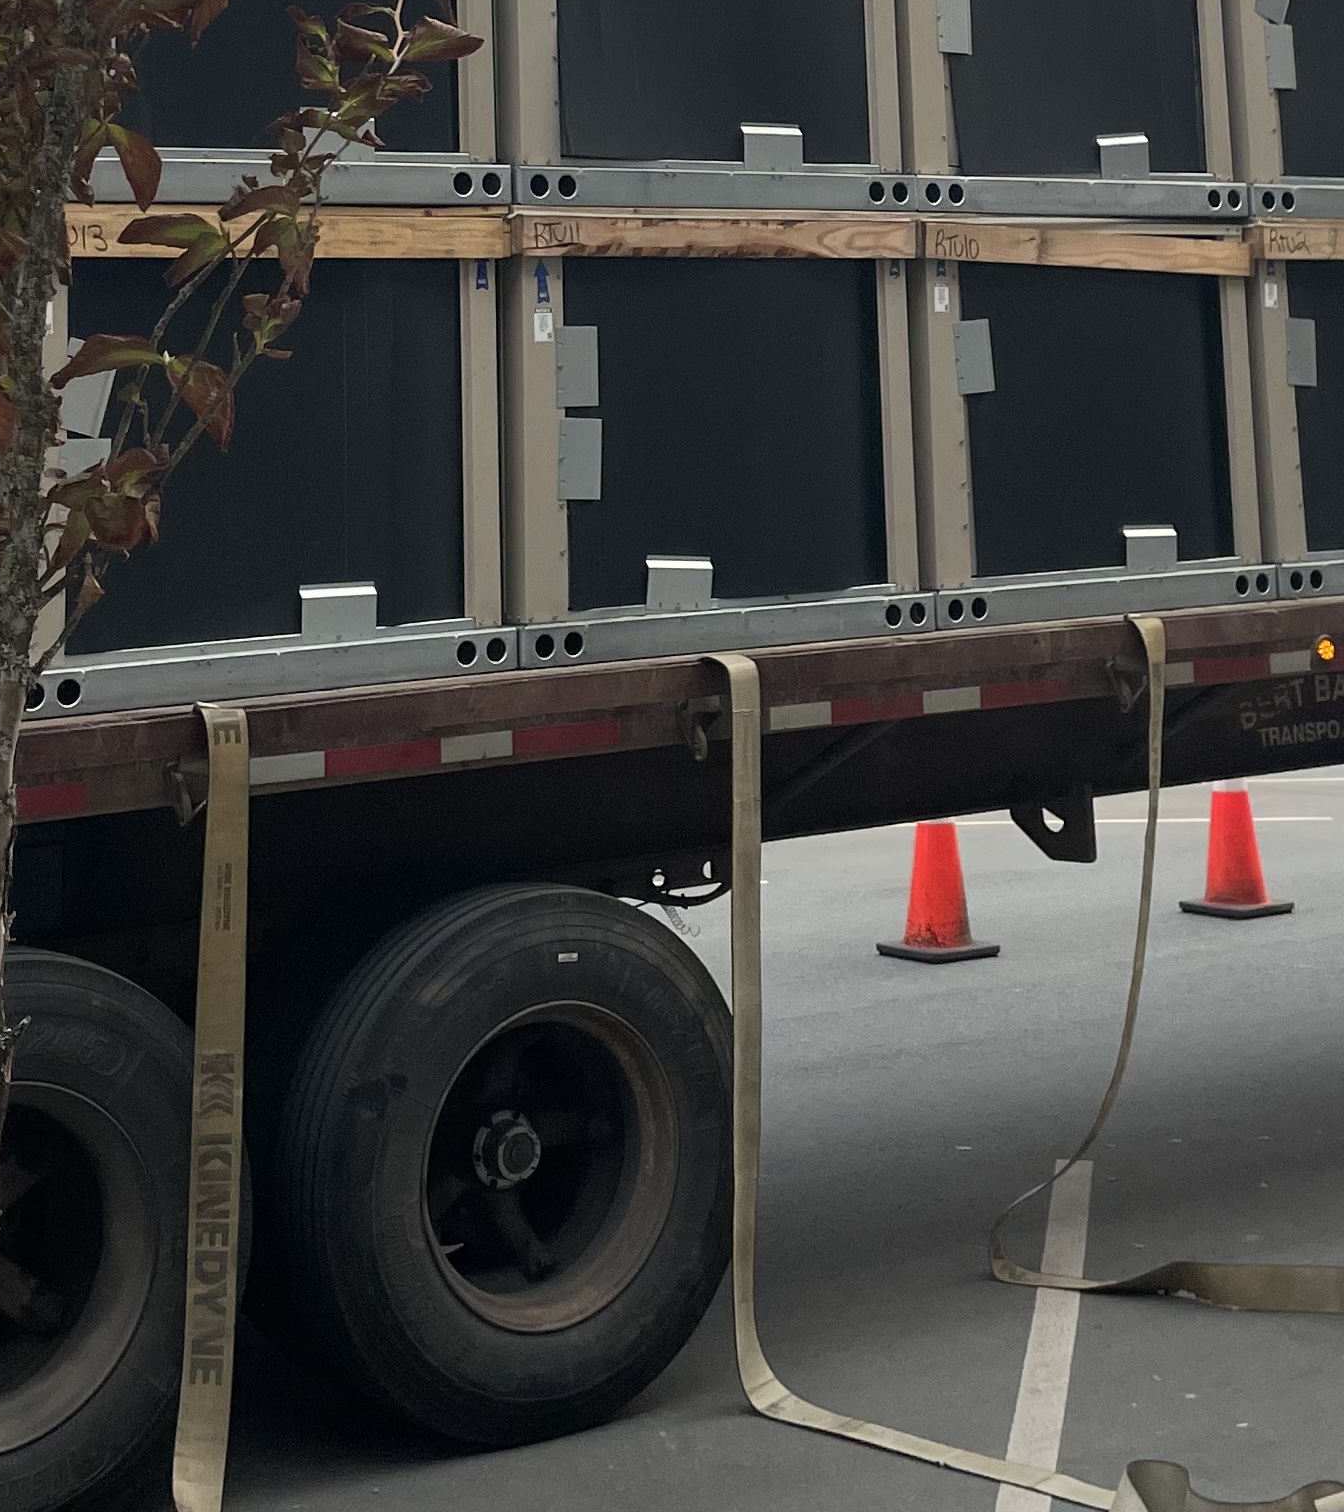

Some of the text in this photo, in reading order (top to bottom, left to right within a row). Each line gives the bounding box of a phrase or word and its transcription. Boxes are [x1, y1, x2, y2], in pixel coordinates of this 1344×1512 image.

[534, 220, 581, 249] RTU11
[934, 228, 980, 260] RTU10
[188, 1132, 233, 1387] KINEDYNE
